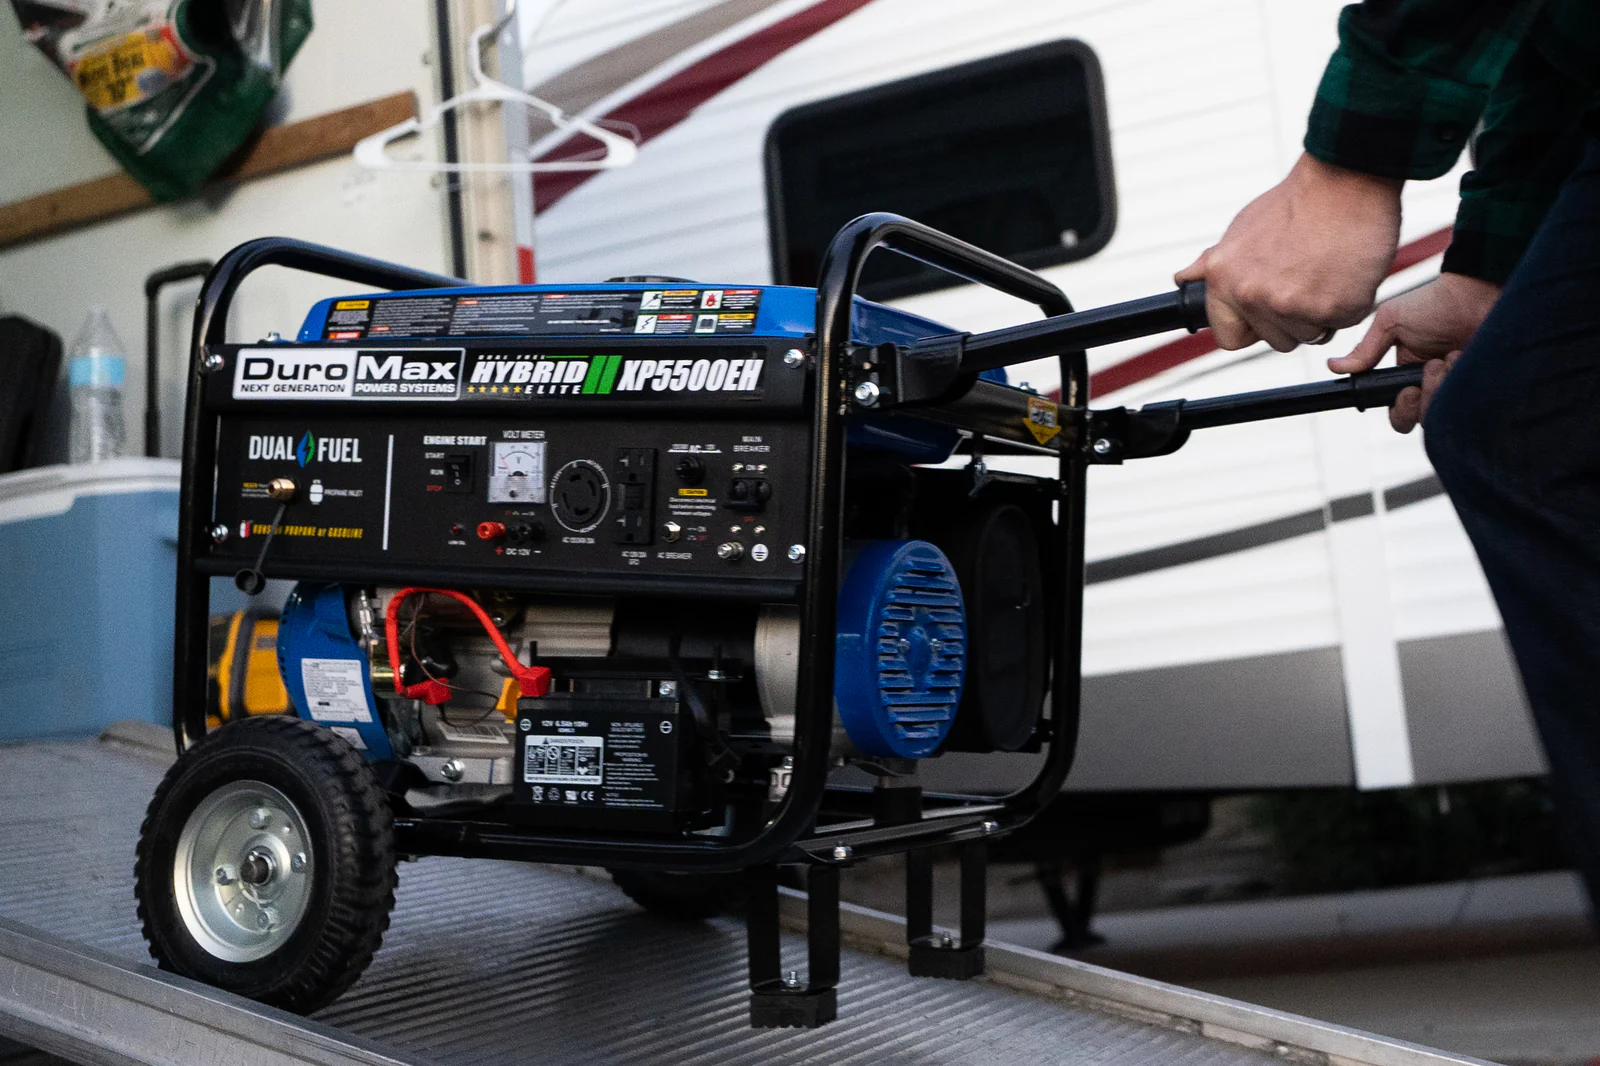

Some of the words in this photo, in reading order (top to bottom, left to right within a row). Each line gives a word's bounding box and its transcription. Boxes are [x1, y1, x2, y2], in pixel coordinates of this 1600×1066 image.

[242, 358, 349, 381] Duro
[356, 355, 456, 381] Max
[469, 361, 589, 384] HYBRID
[616, 359, 764, 392] XP5500EH
[240, 384, 270, 393] NEXT
[273, 384, 346, 393] GENERATION
[354, 383, 397, 393] POWER
[399, 384, 456, 394] SYSTEMS
[524, 385, 582, 394] ELITE
[502, 430, 520, 438] VOLT
[521, 430, 546, 439] METER
[423, 435, 456, 445] ENGINE
[456, 435, 487, 446] START
[248, 435, 297, 460] DUAL
[317, 437, 363, 463] FUEL
[733, 445, 771, 453] BREAKER
[284, 525, 317, 536] PROPANE
[327, 526, 363, 539] GASOLINE
[505, 548, 518, 556] DC
